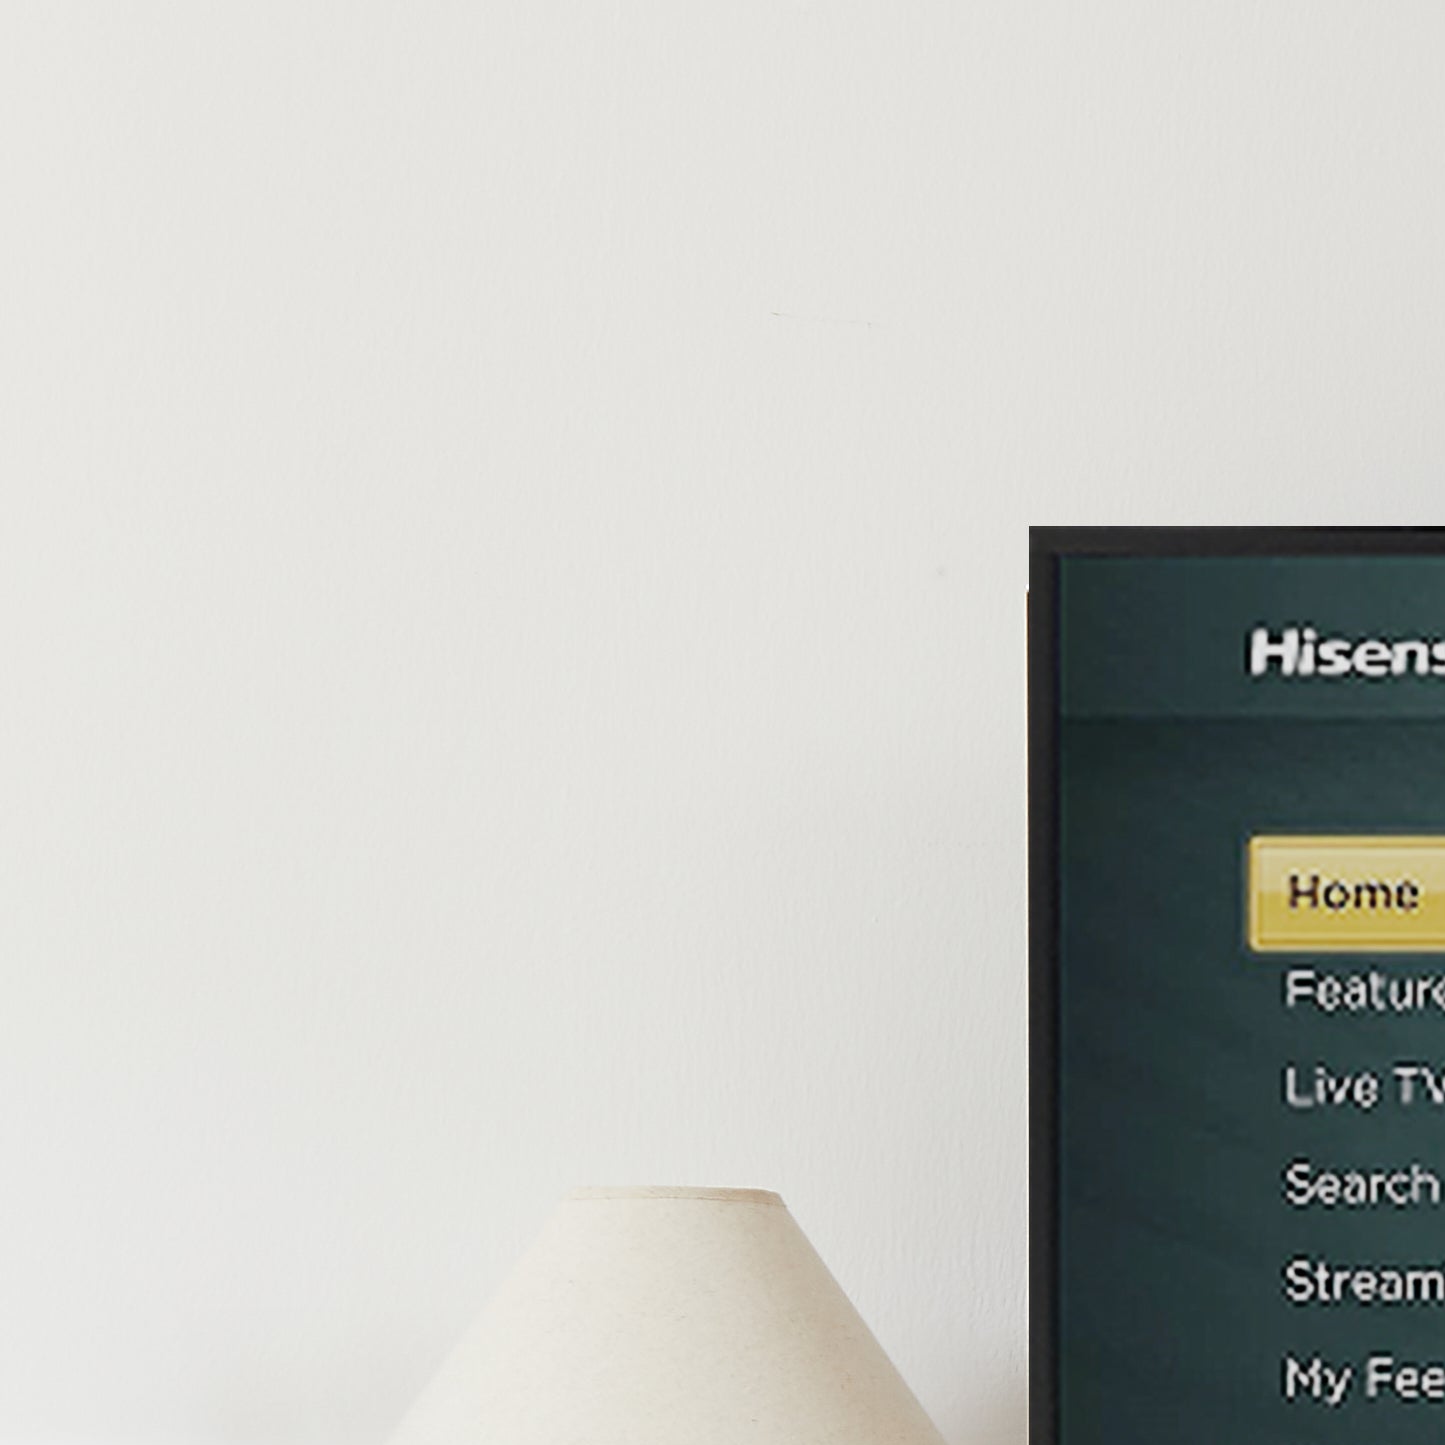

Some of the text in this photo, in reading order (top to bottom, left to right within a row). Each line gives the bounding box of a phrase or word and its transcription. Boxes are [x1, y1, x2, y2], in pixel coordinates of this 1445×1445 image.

[1289, 874, 1419, 909] Home
[1287, 1067, 1378, 1108] Live
[1286, 1164, 1440, 1205] Search
[1286, 1358, 1352, 1404] My
